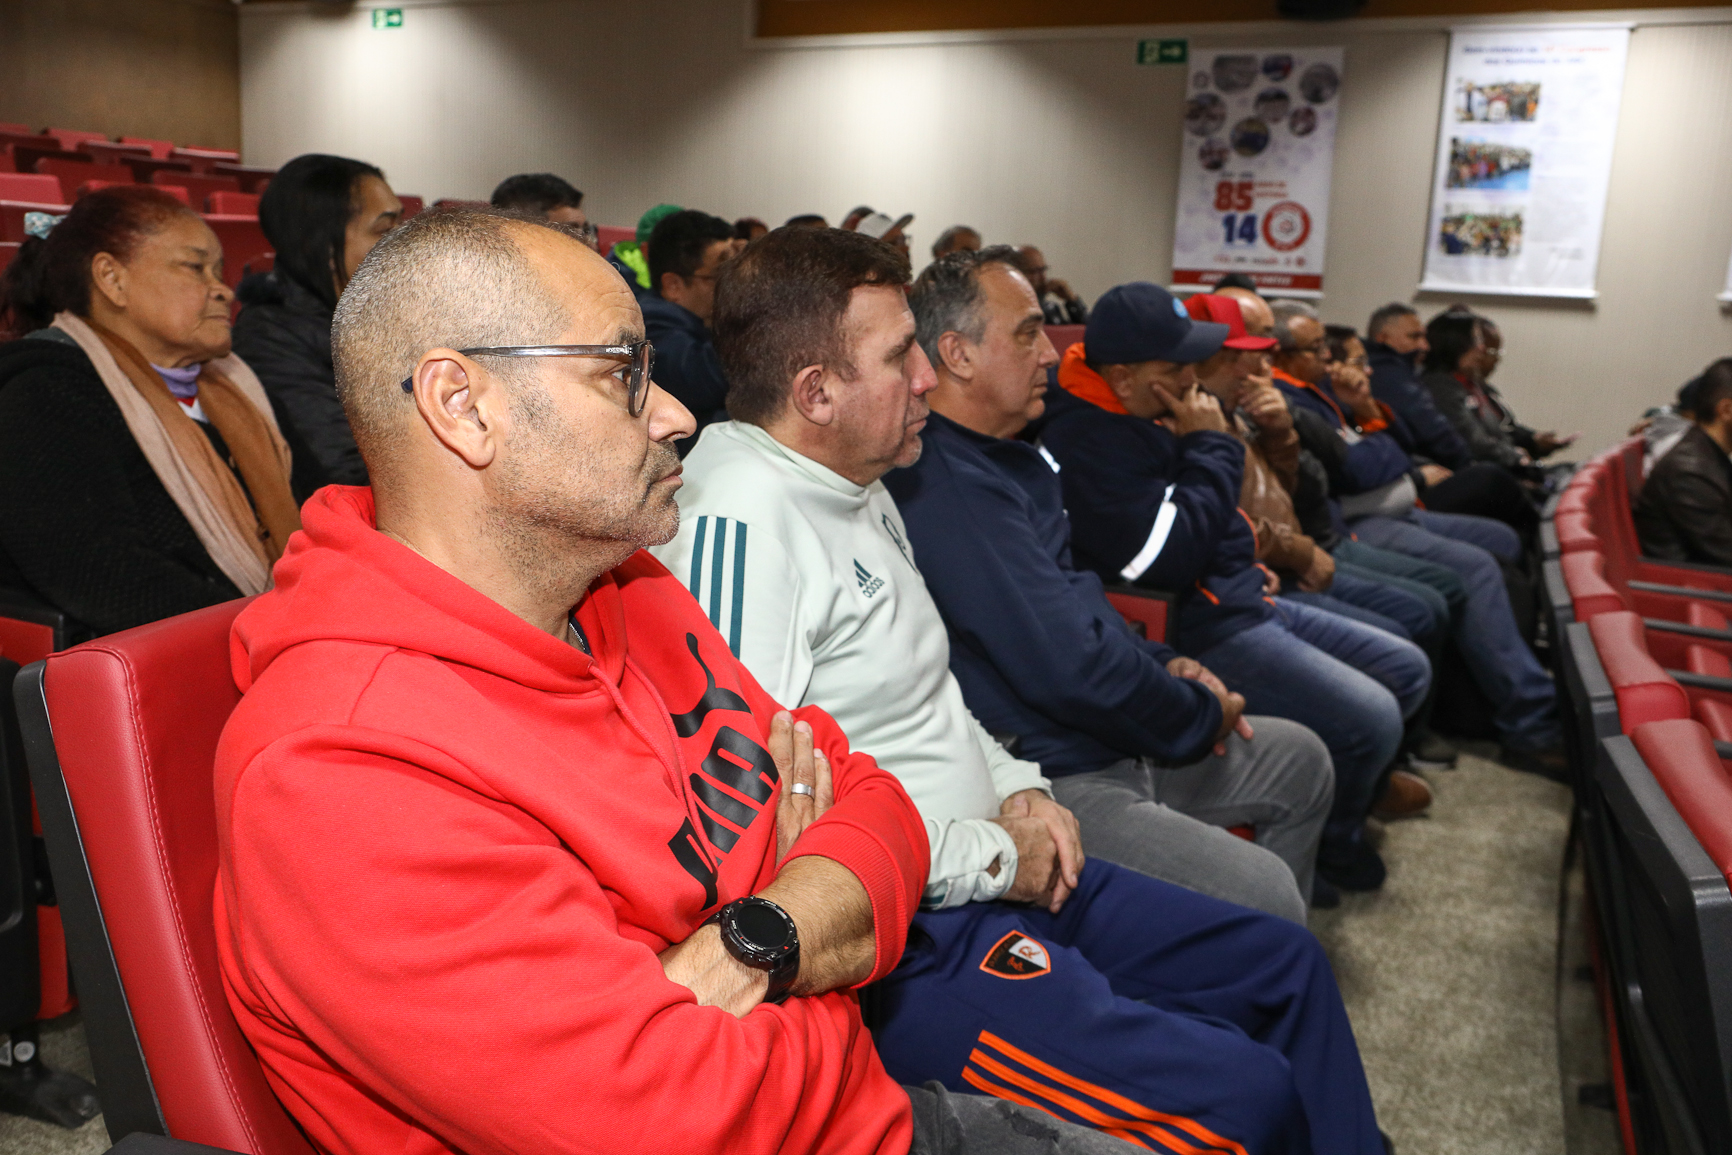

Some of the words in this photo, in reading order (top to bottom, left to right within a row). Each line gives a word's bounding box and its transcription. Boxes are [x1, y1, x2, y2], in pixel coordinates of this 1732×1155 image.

[1214, 180, 1255, 212] 85
[1222, 214, 1258, 244] 14
[667, 725, 780, 912] PMA
